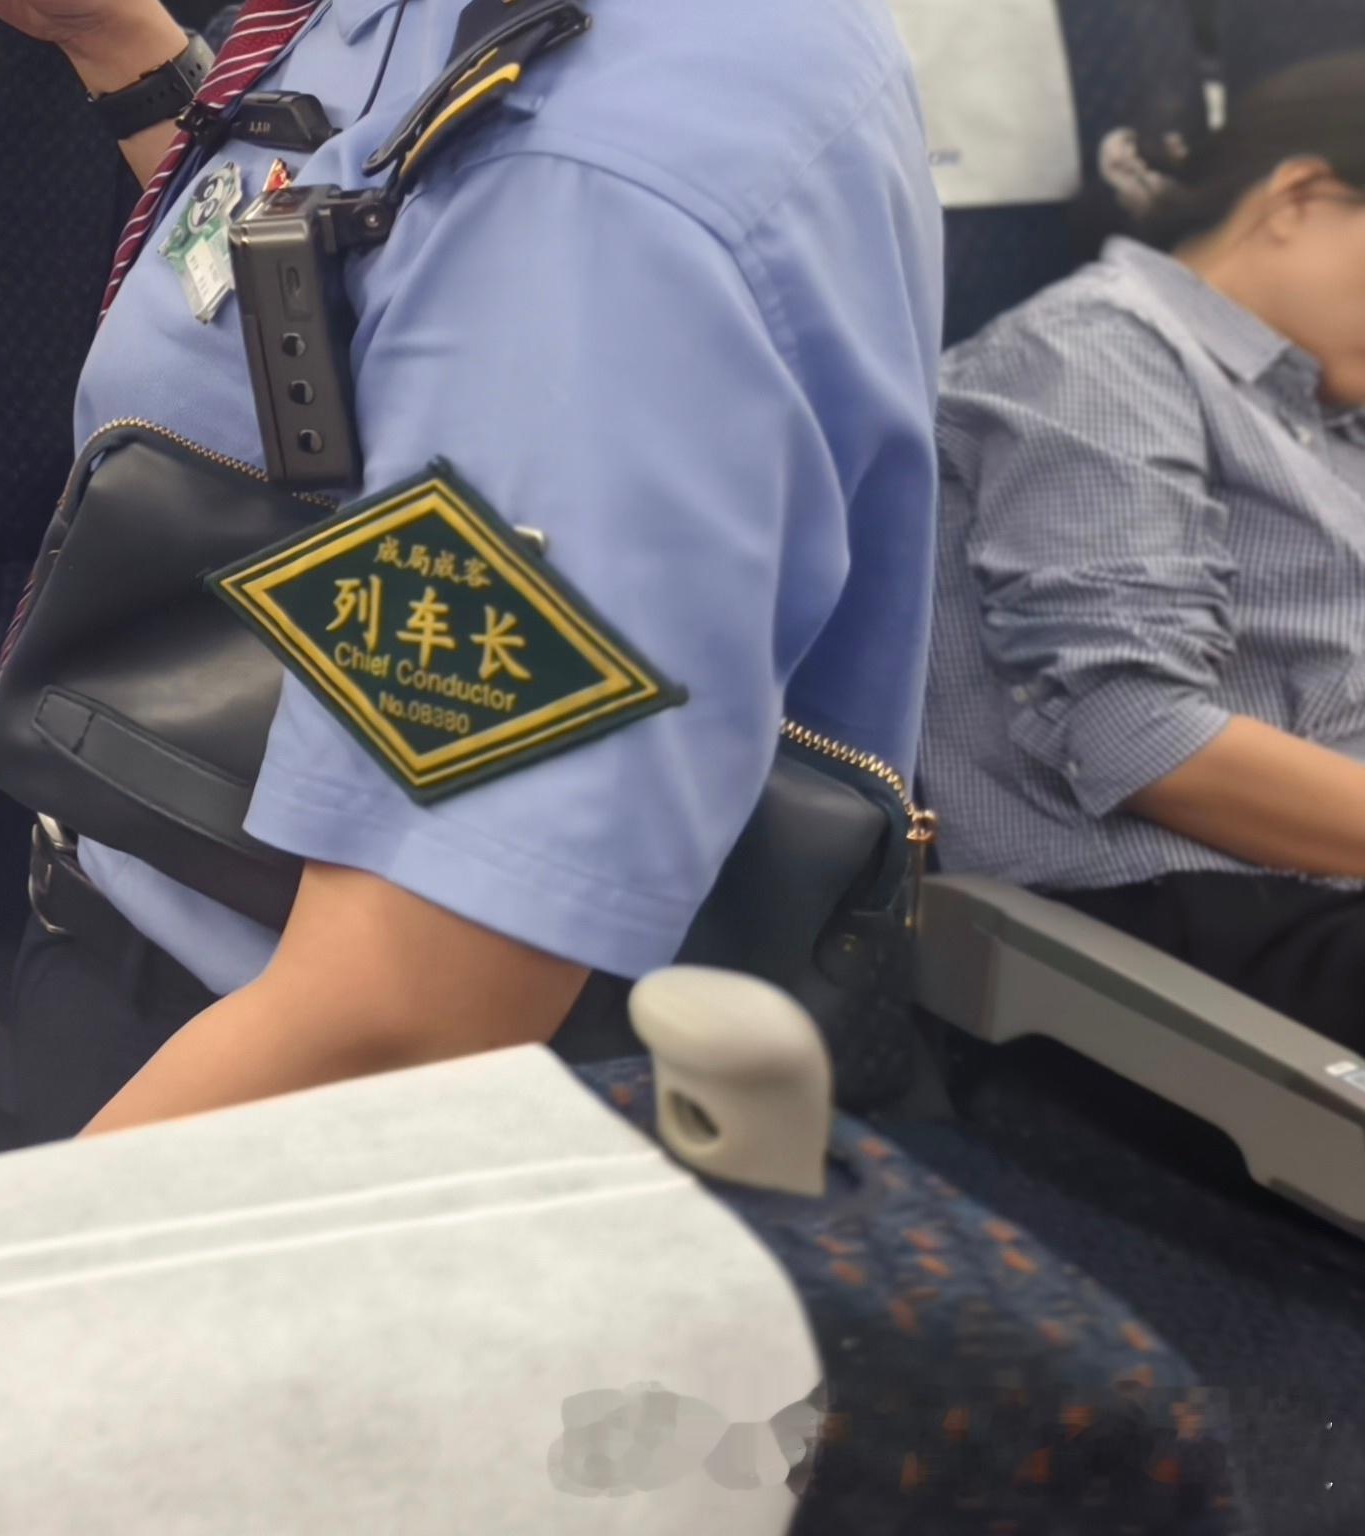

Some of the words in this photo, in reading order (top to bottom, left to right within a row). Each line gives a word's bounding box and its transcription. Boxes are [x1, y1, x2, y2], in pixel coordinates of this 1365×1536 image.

[325, 573, 532, 682] 列车长
[333, 640, 392, 679] Chief
[395, 658, 518, 713] Conductor
